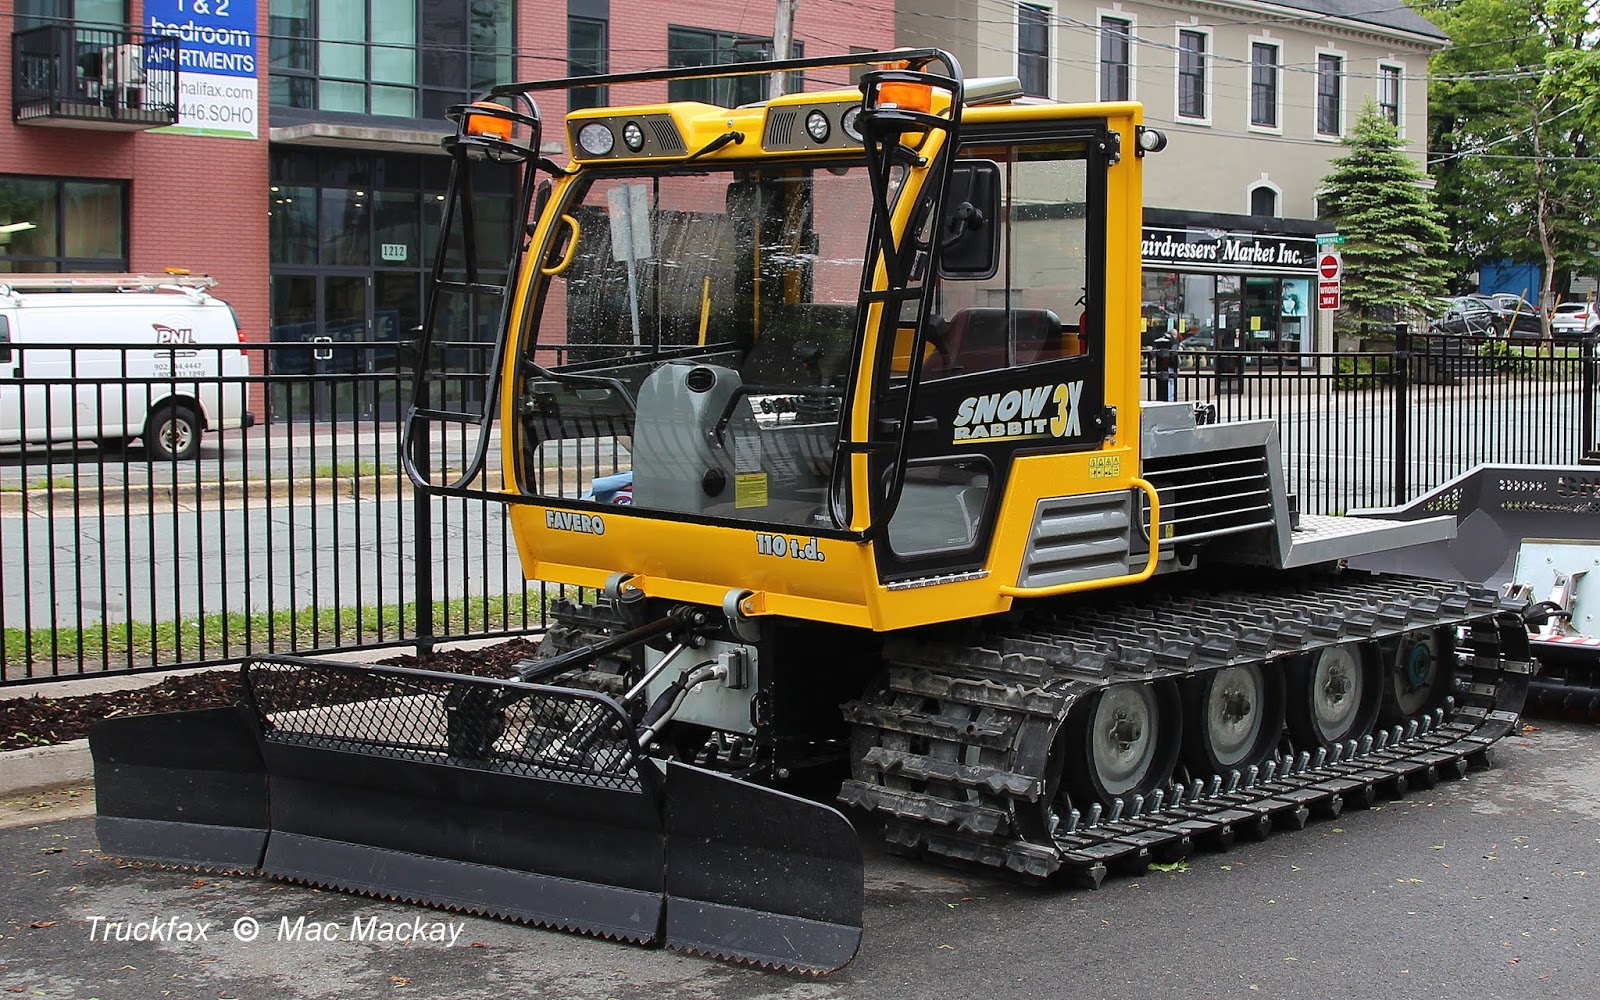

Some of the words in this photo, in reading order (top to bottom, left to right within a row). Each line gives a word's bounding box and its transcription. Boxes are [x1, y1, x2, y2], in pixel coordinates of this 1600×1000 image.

[193, 0, 210, 15] &
[215, 0, 229, 17] 2
[151, 16, 251, 48] bedroom
[179, 103, 253, 124] 446.SOHO
[383, 245, 405, 257] 1212
[1141, 233, 1222, 260] airdressers'
[1223, 239, 1276, 263] Market
[1277, 243, 1303, 265] Inc.
[1319, 286, 1339, 295] WRONG
[1322, 297, 1335, 305] WAY
[953, 385, 1053, 427] SNOW
[953, 419, 1048, 440] RABBIT
[545, 509, 605, 536] FAVERO
[756, 533, 787, 558] 110
[789, 536, 826, 562] t.d.
